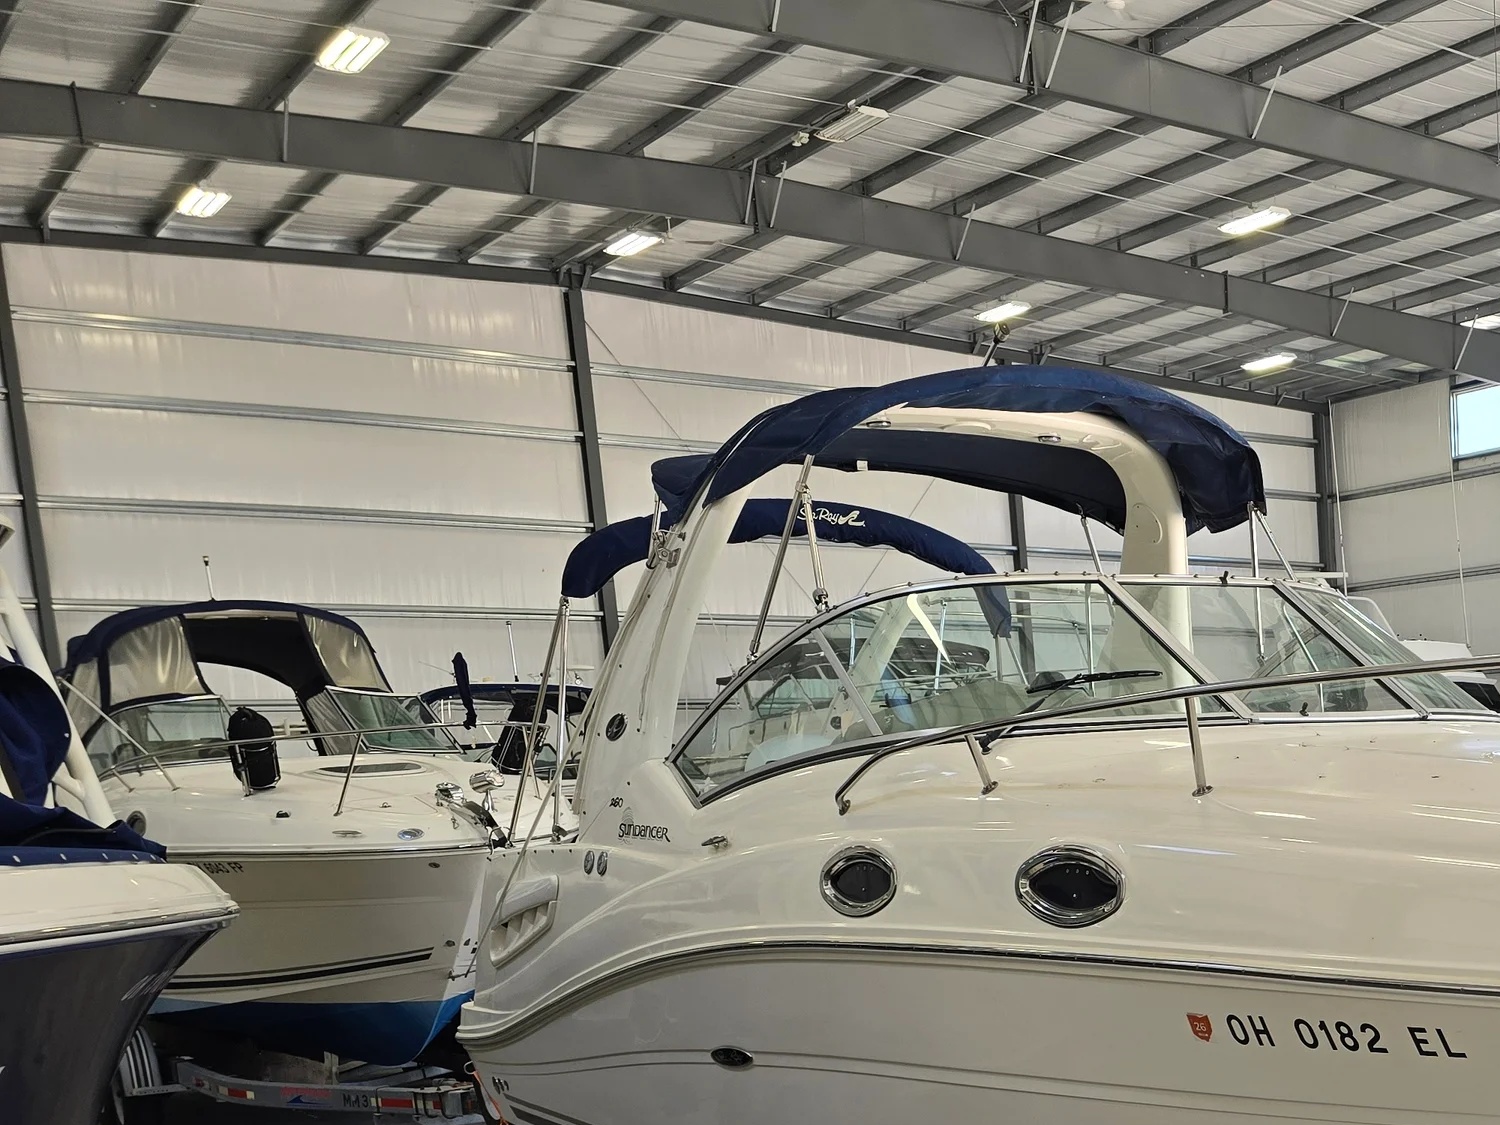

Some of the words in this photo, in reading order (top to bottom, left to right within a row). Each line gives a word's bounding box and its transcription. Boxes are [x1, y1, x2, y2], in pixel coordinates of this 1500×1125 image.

[797, 507, 818, 520] Sa
[816, 507, 840, 525] Ray
[227, 862, 244, 873] FP
[1193, 1021, 1207, 1032] 26
[1226, 1014, 1276, 1047] OH
[1294, 1018, 1389, 1053] 0182
[1407, 1026, 1468, 1059] EL
